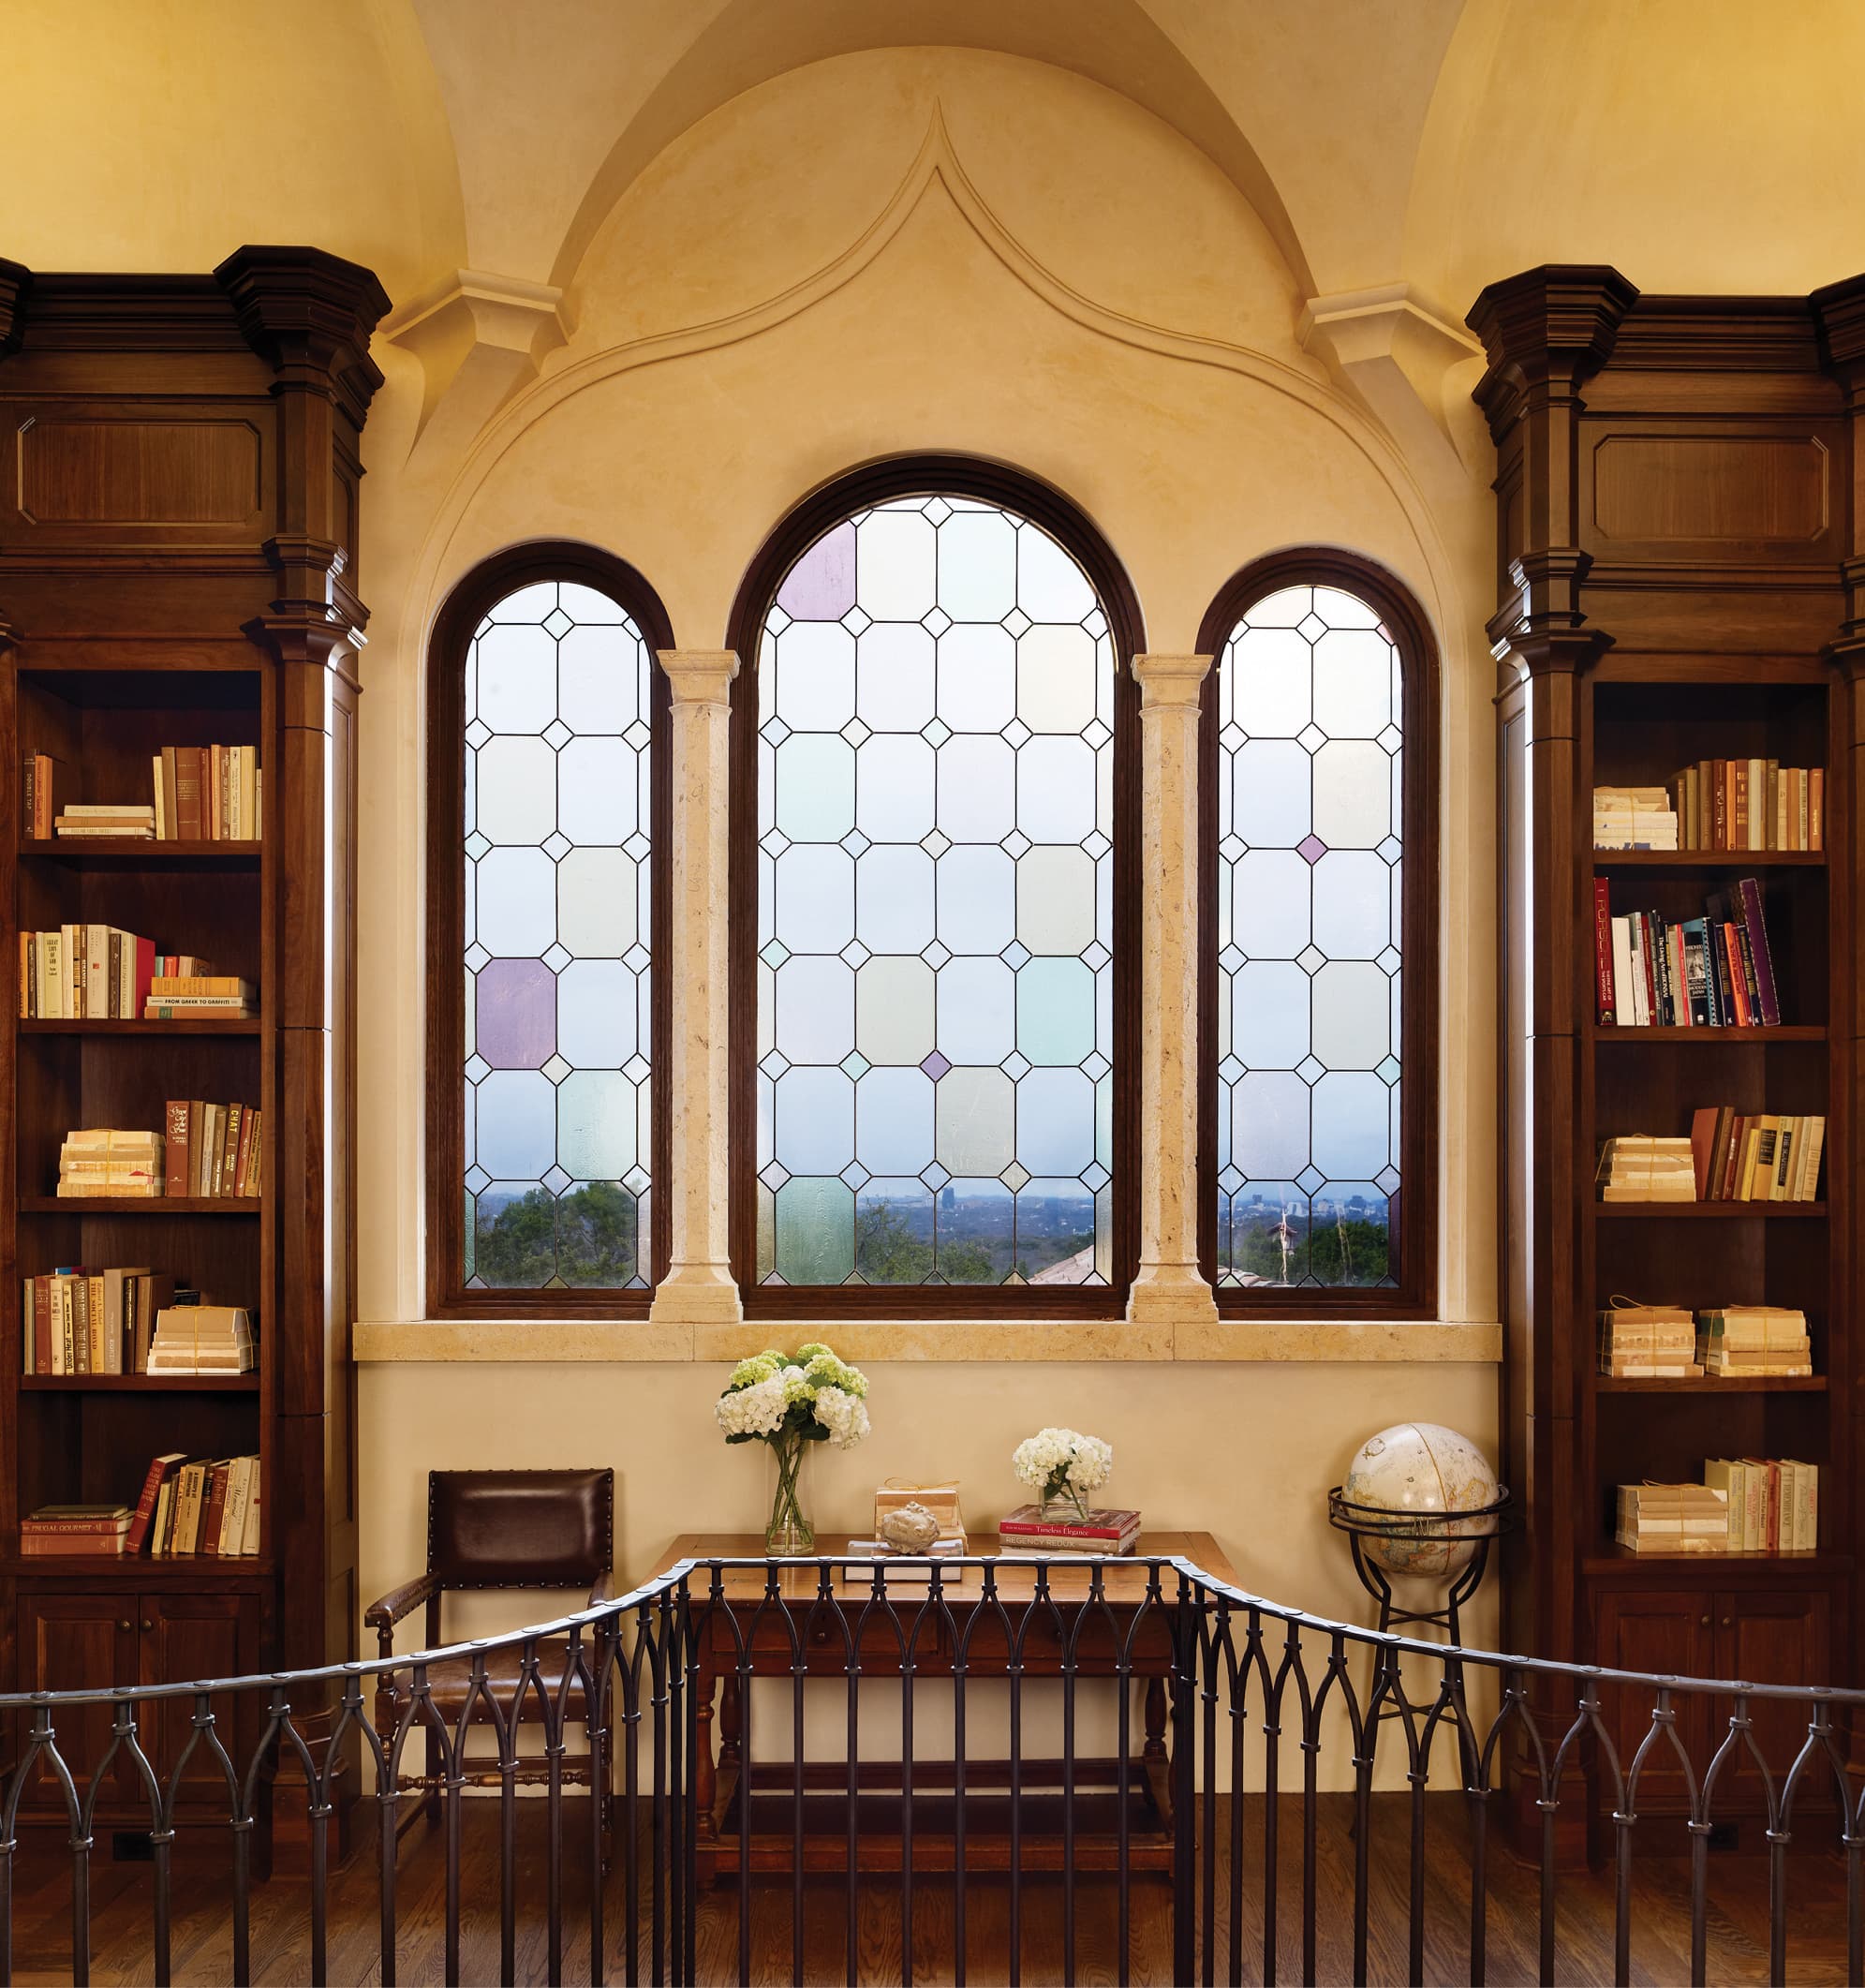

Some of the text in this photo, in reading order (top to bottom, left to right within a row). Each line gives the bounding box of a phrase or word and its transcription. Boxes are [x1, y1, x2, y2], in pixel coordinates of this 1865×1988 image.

[229, 1109, 239, 1132] CHAT
[1035, 1525, 1062, 1535] Timeless
[1063, 1528, 1088, 1536] Elegance
[1005, 1536, 1074, 1547] REGENCY REDUX
